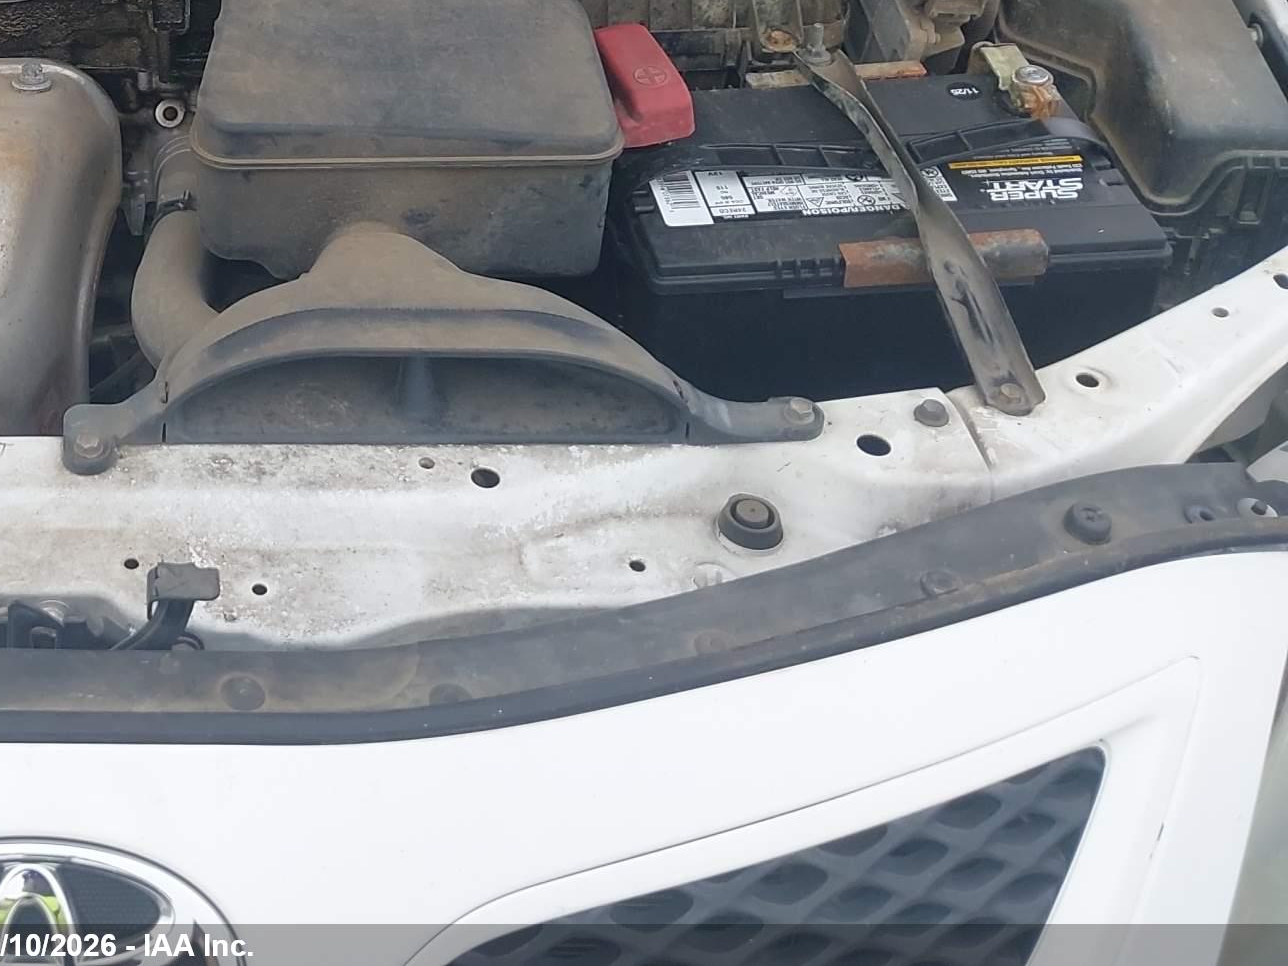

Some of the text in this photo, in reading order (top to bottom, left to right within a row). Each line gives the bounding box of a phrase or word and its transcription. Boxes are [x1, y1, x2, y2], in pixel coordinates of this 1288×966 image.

[987, 178, 1083, 192] START
[991, 189, 1078, 201] SUPER
[802, 202, 901, 217] DANGER/POISON
